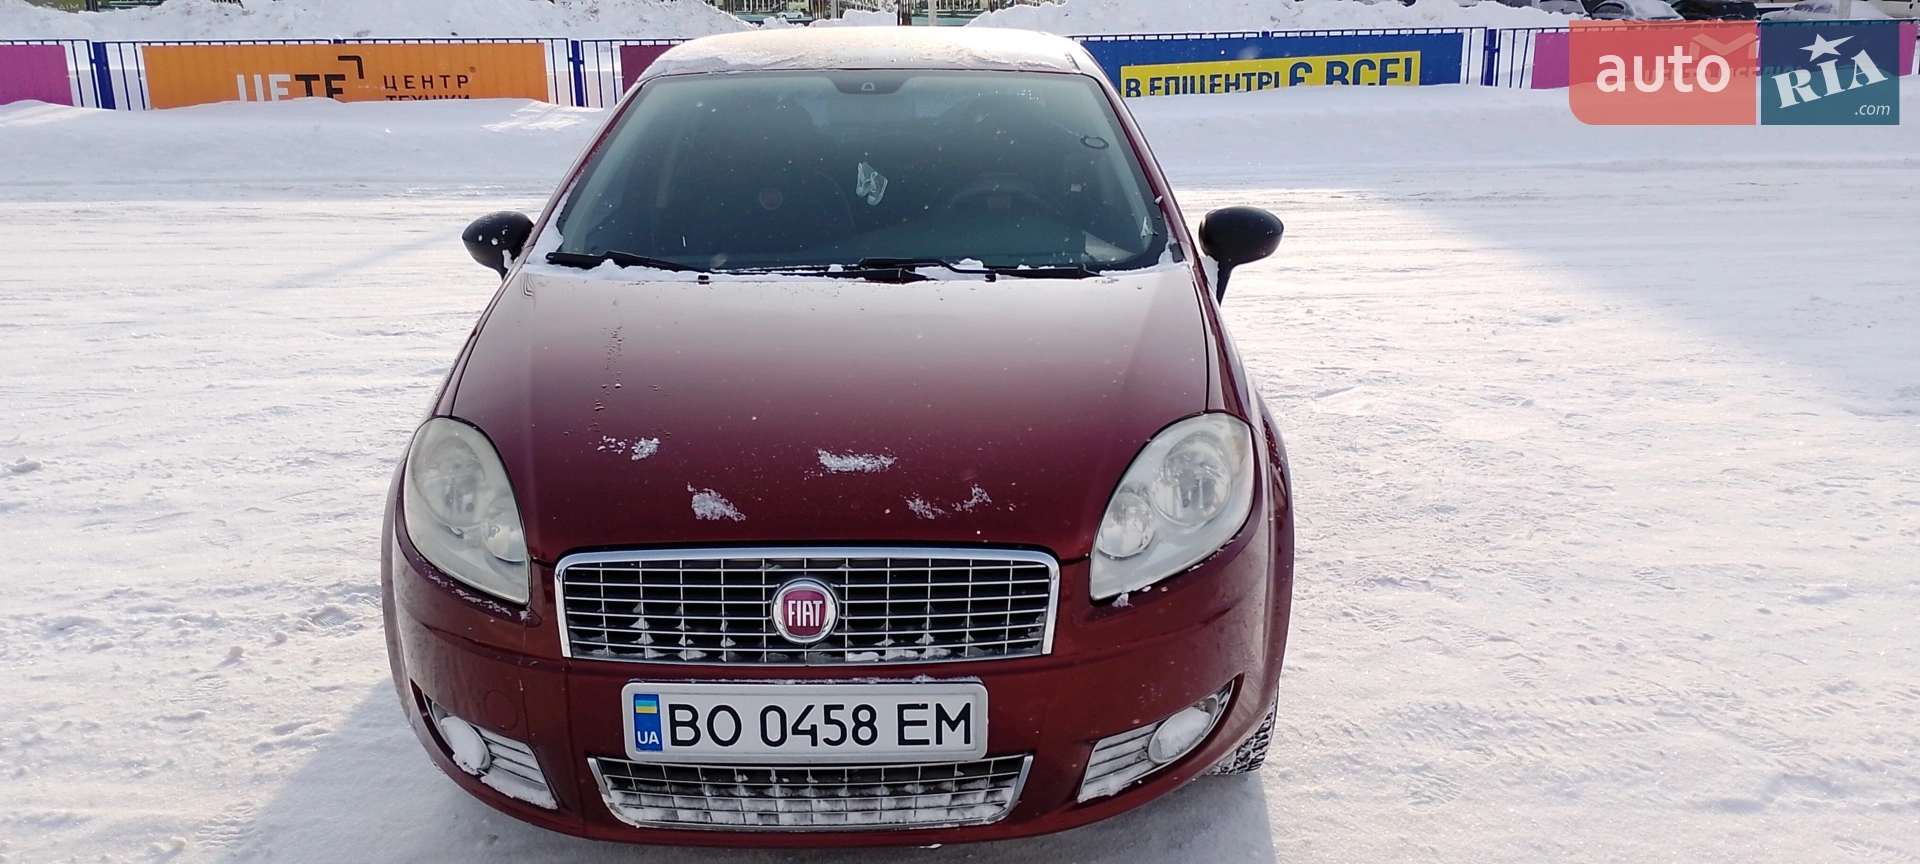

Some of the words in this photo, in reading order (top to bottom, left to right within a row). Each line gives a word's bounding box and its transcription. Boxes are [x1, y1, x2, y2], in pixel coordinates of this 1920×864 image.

[383, 74, 469, 91] ЦЕНТР
[1125, 78, 1141, 97] В
[787, 600, 823, 627] FIAT
[668, 703, 742, 747] BO
[759, 703, 879, 748] 0458
[897, 702, 972, 746] EM
[637, 729, 660, 745] UA
